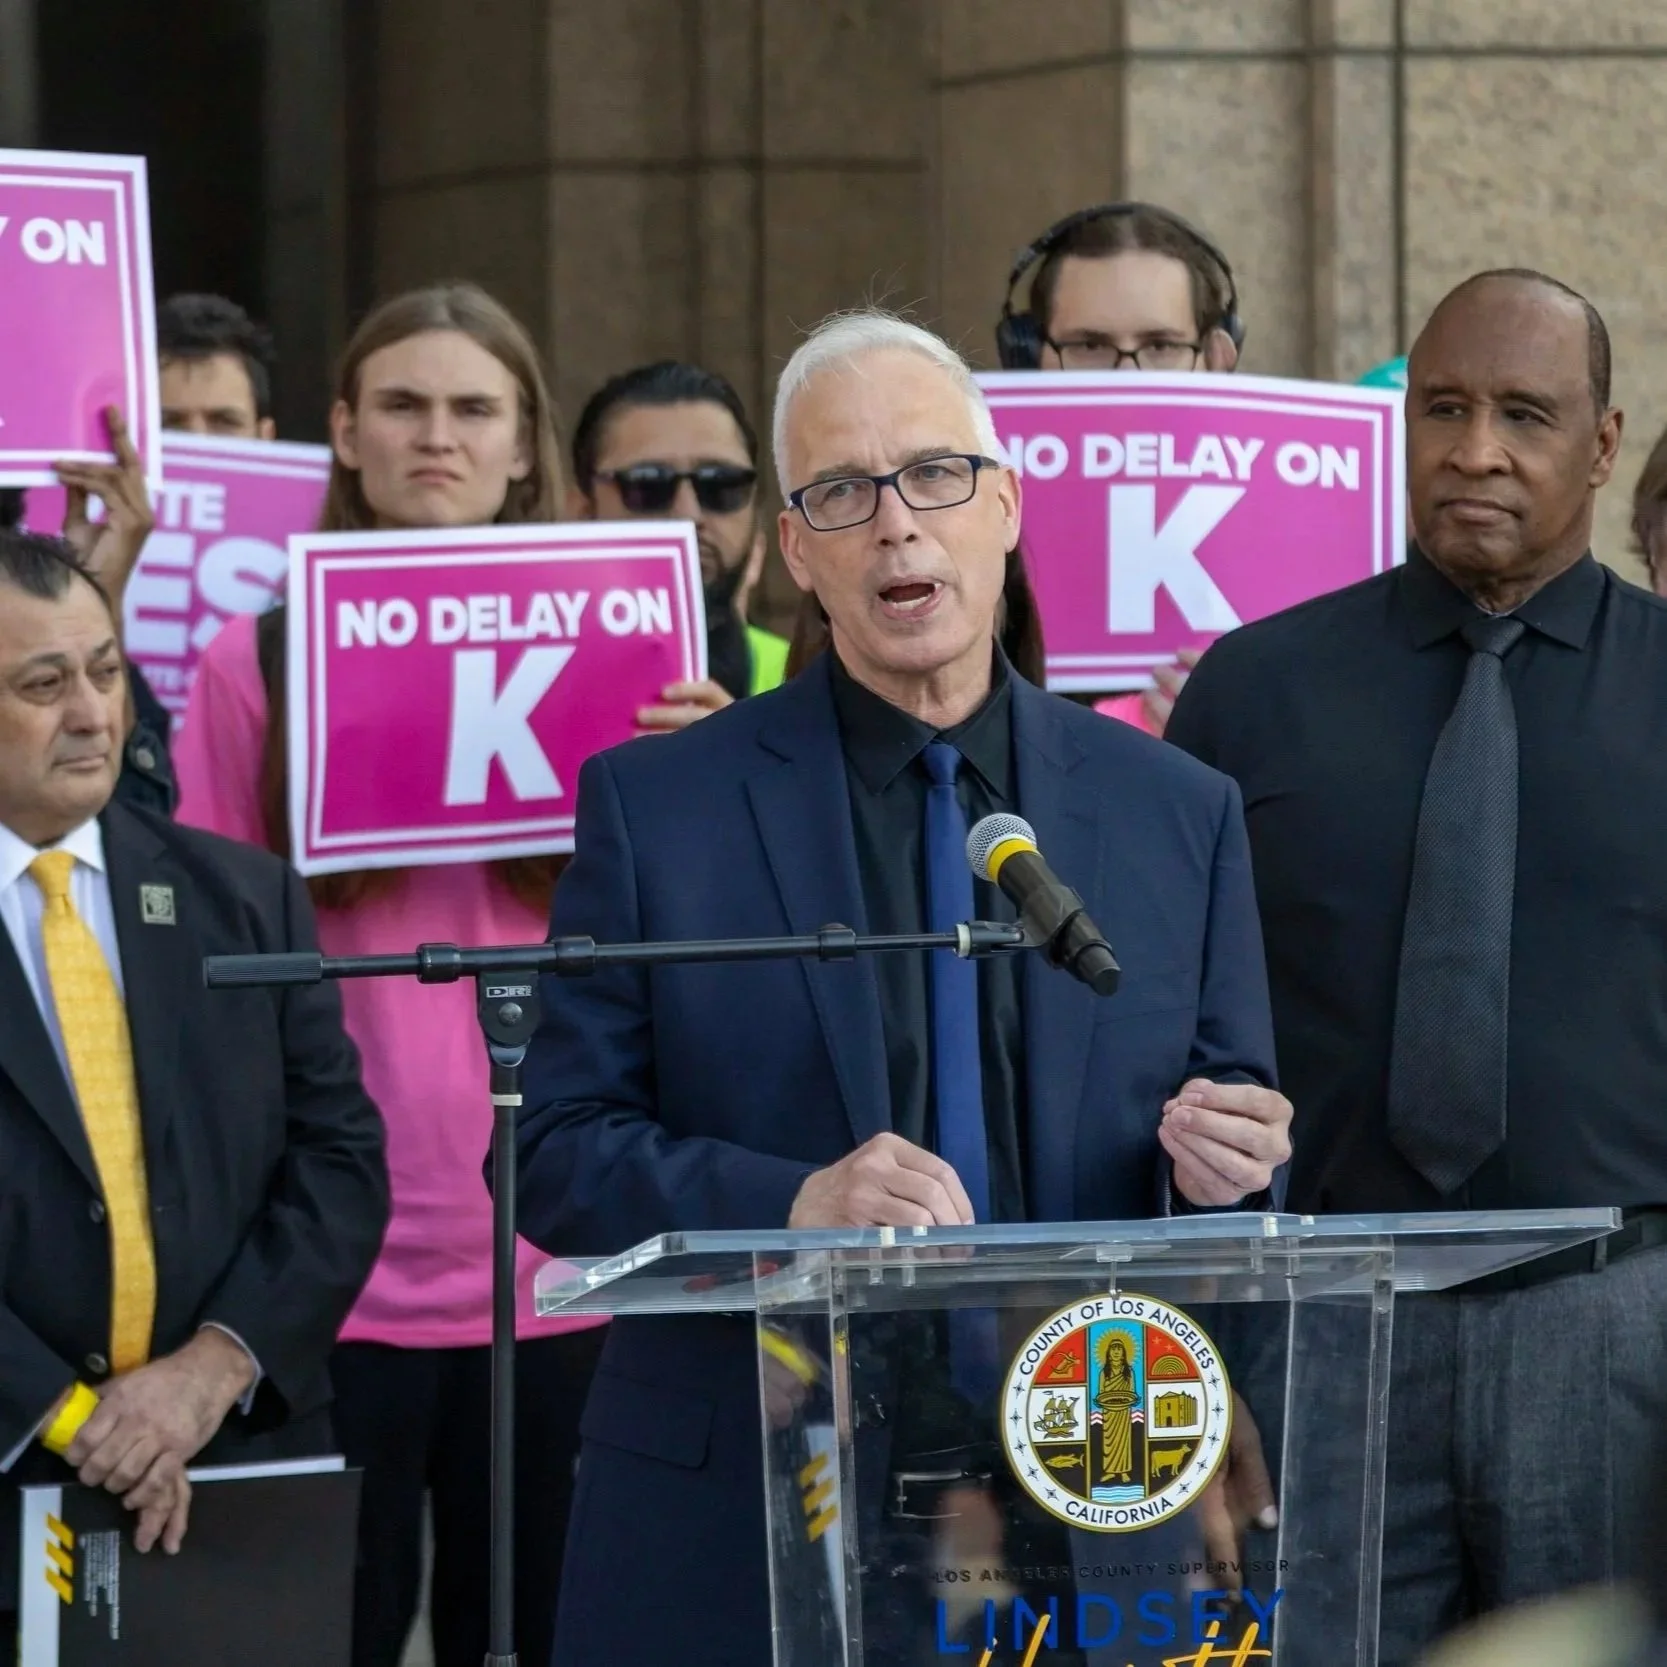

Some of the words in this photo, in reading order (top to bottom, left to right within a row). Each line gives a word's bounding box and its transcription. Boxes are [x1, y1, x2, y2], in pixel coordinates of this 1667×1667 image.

[21, 217, 107, 266] ON
[1081, 433, 1264, 481] DELAY
[1275, 442, 1360, 490] ON
[154, 480, 226, 532] TE
[1108, 483, 1247, 634] K
[123, 530, 289, 656] ES
[337, 599, 418, 648] NO
[429, 590, 590, 645] DELAY
[599, 587, 673, 636] ON
[443, 644, 577, 807] K
[1020, 1312, 1073, 1375] COUNTY
[1081, 1302, 1104, 1320] OF
[1112, 1300, 1145, 1317] LOS
[1149, 1308, 1215, 1370] ANGELES
[1065, 1496, 1175, 1525] CALIFORNIA
[935, 1569, 971, 1584] LOS
[980, 1565, 1072, 1583] ANELES
[1079, 1563, 1158, 1579] COUNTY
[1167, 1559, 1290, 1576] SUPERVSOR
[935, 1588, 1285, 1654] LINDSEY
